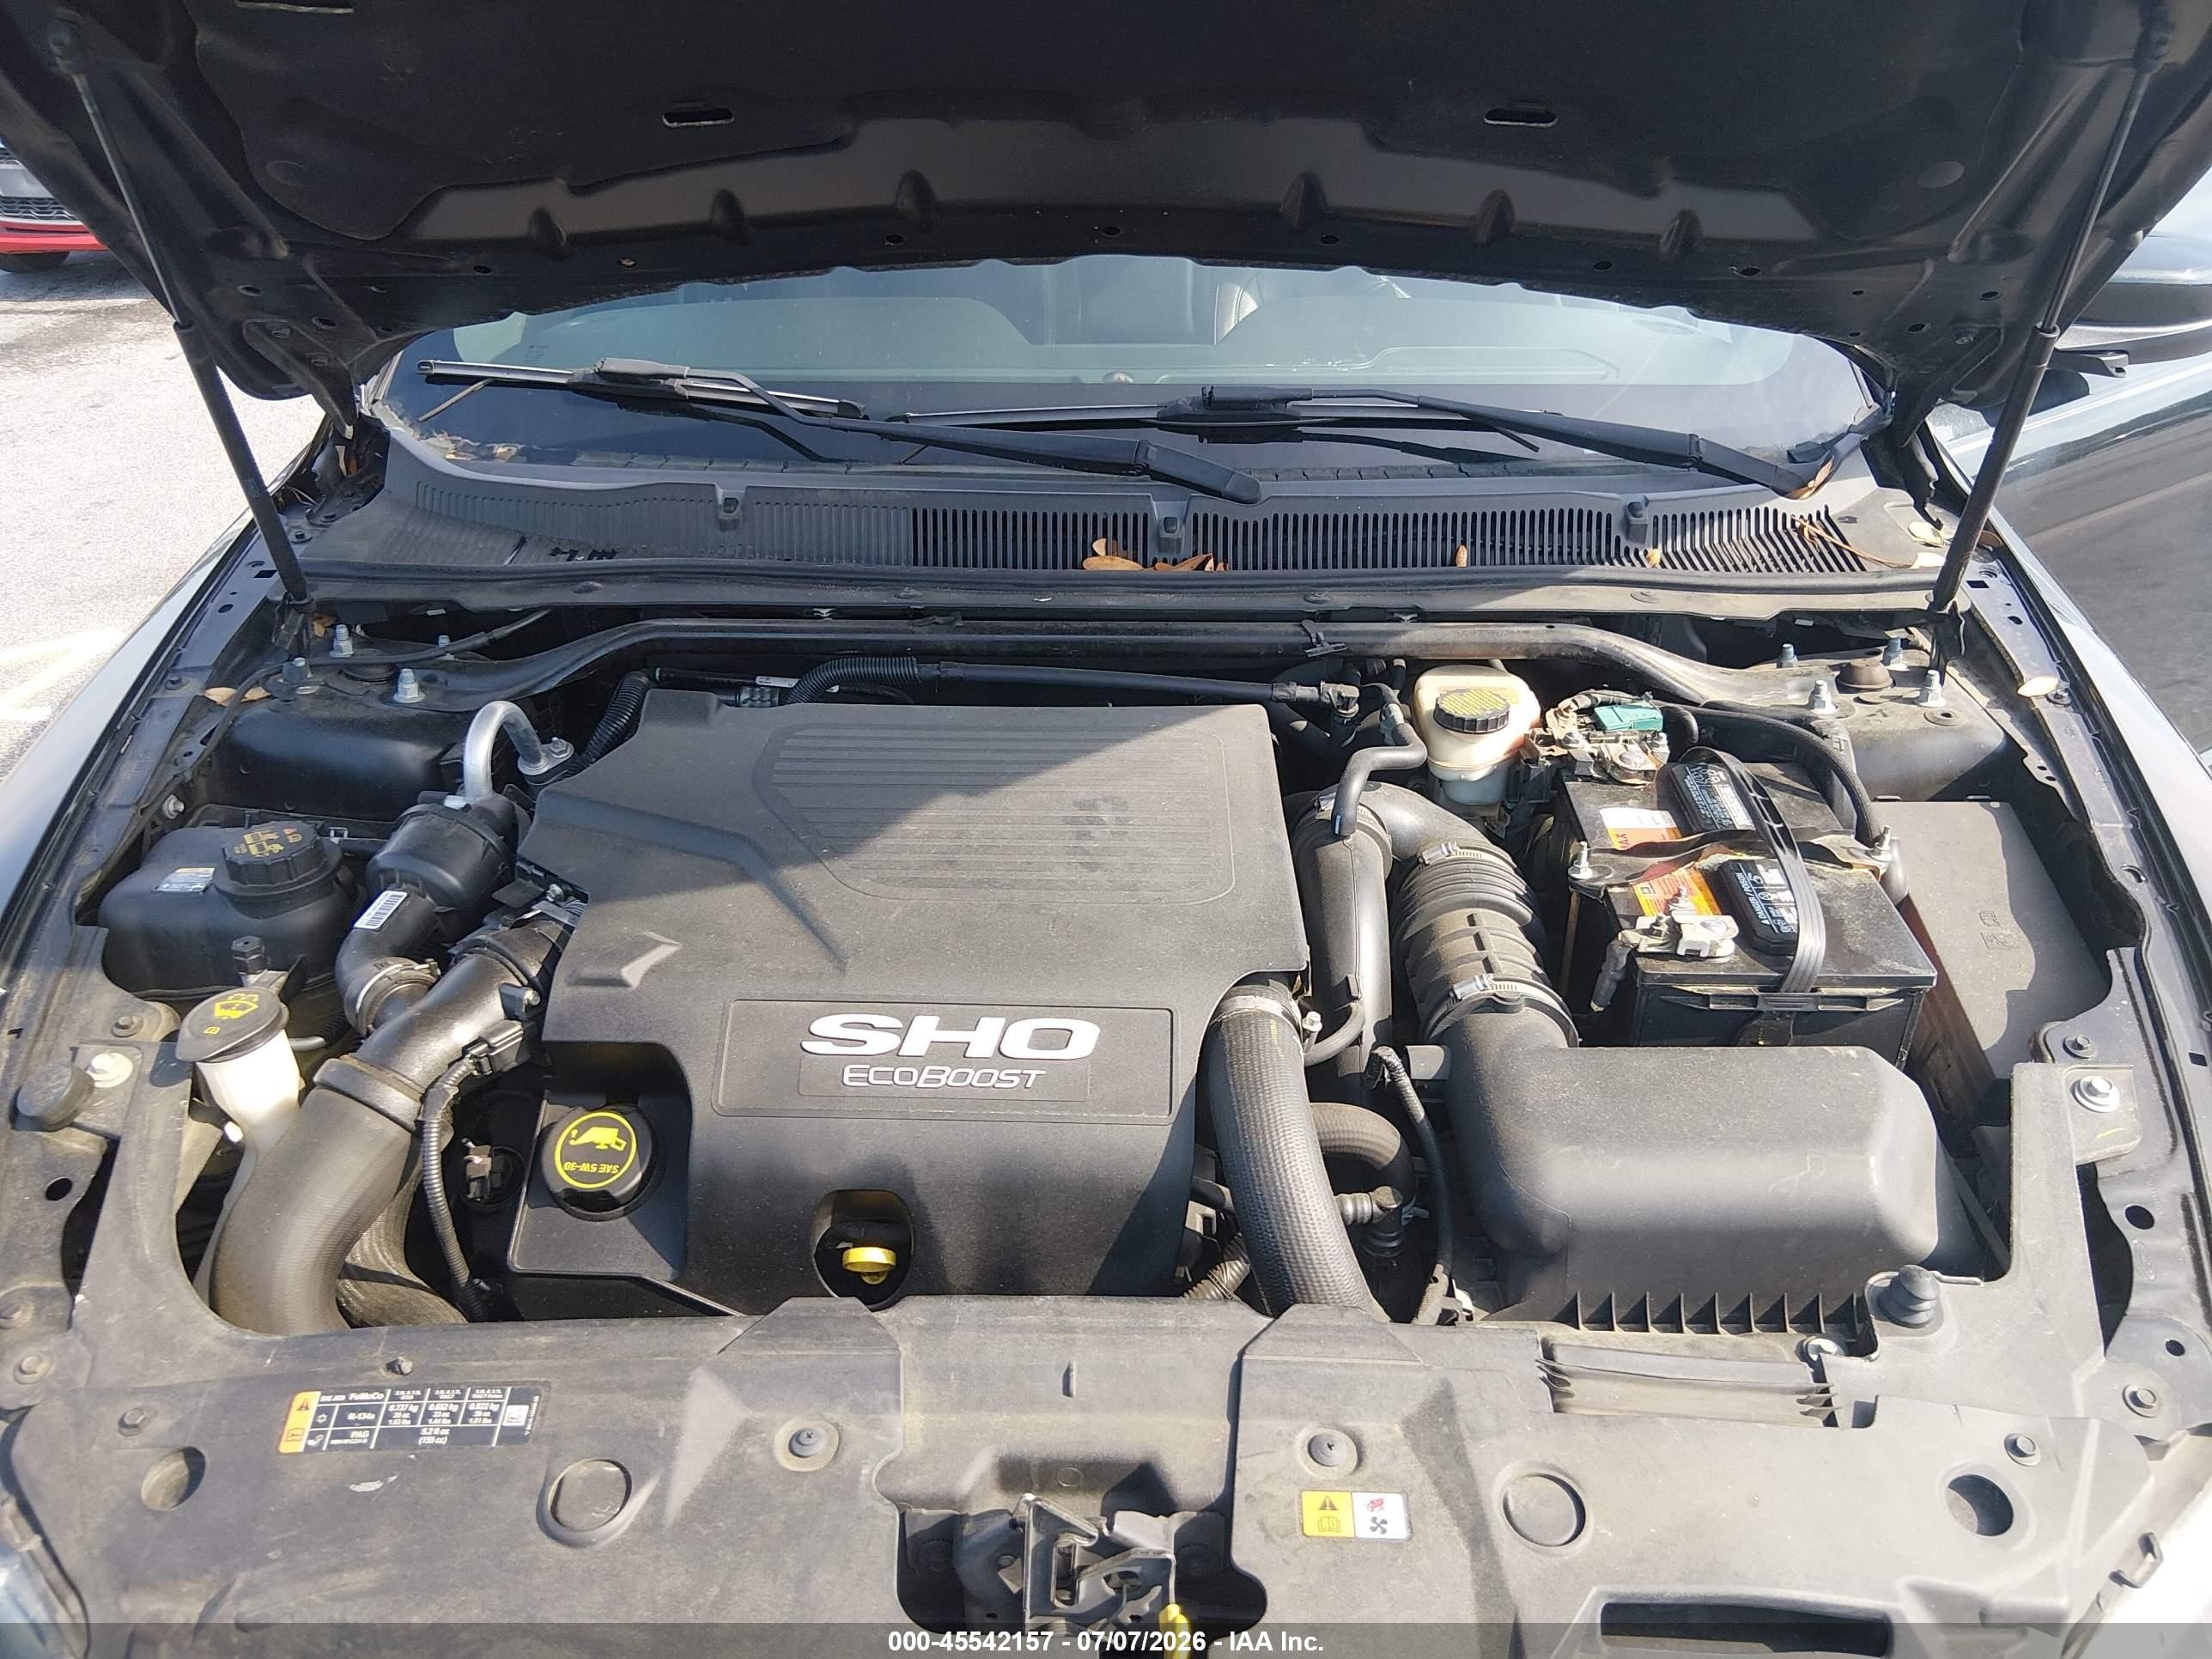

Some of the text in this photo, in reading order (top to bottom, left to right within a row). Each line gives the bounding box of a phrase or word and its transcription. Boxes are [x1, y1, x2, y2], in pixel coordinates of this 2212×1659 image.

[1735, 872, 1753, 892] POISON
[1748, 897, 1766, 919] DANGER
[800, 1013, 1101, 1060] SHO
[563, 1161, 620, 1174] SAE 5W-30
